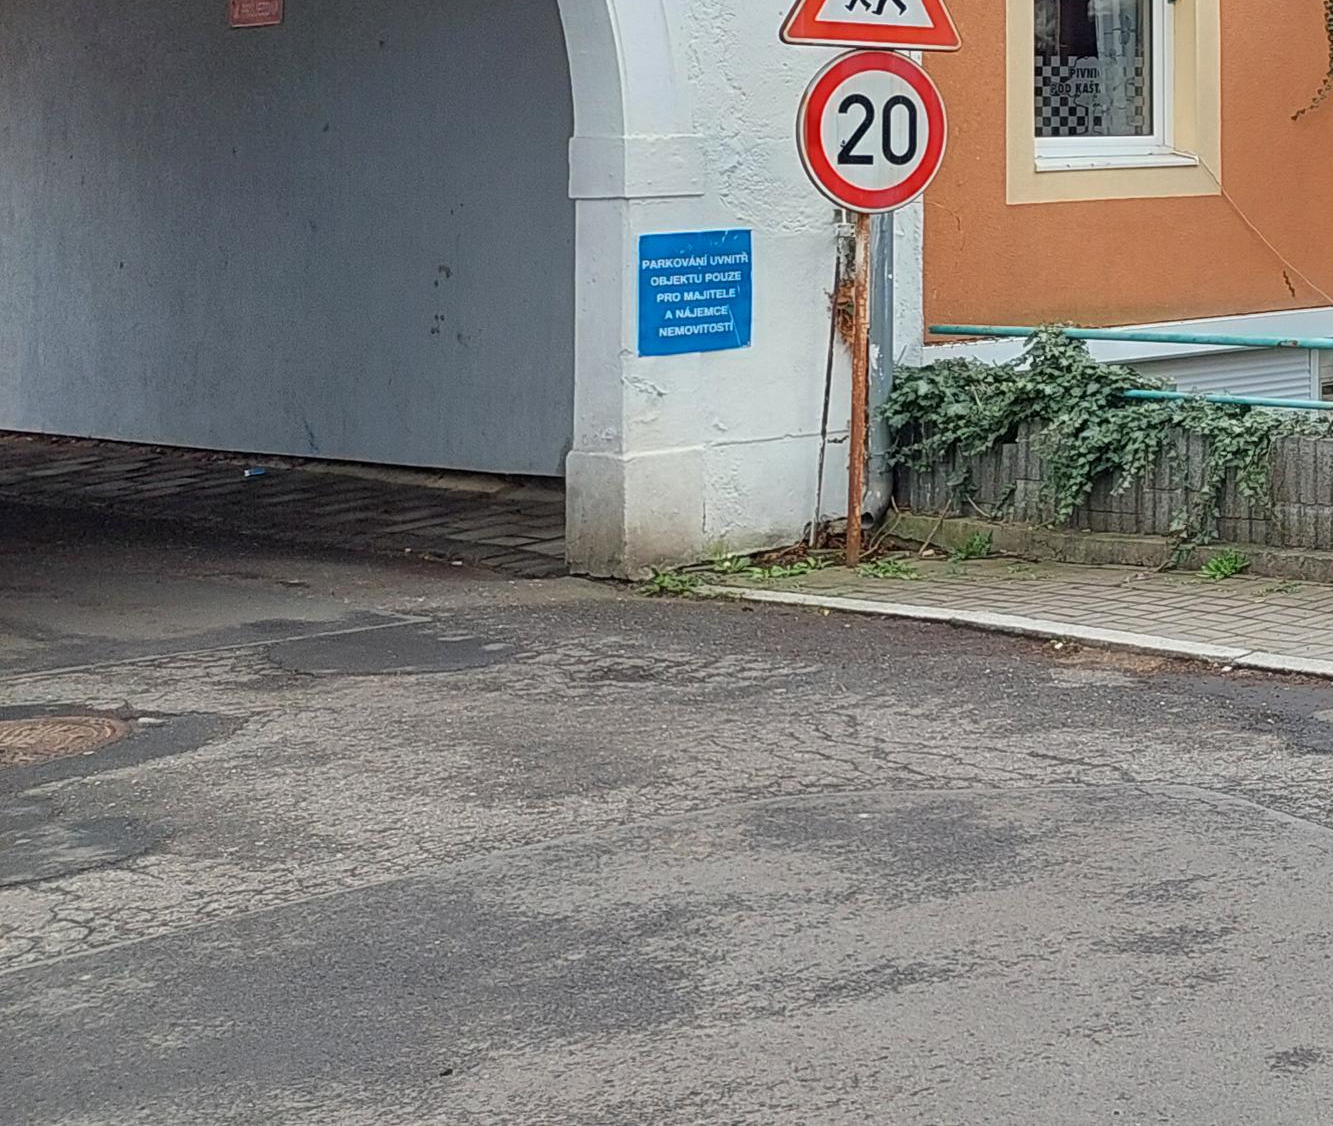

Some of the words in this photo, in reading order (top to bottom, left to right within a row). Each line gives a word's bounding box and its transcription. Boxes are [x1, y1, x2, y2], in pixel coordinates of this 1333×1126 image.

[1070, 67, 1101, 78] PIVNI
[1075, 80, 1101, 94] KAŠT
[838, 93, 918, 166] 20
[642, 254, 707, 270] PARKOVÁNÍ
[710, 251, 749, 266] UVNITŘ
[650, 274, 702, 286] OBJEKTU
[705, 271, 742, 283] POUZE
[656, 293, 681, 303] PRO
[684, 288, 736, 301] MAJITELE
[664, 309, 673, 320] A
[676, 305, 728, 318] NÁJEMCE
